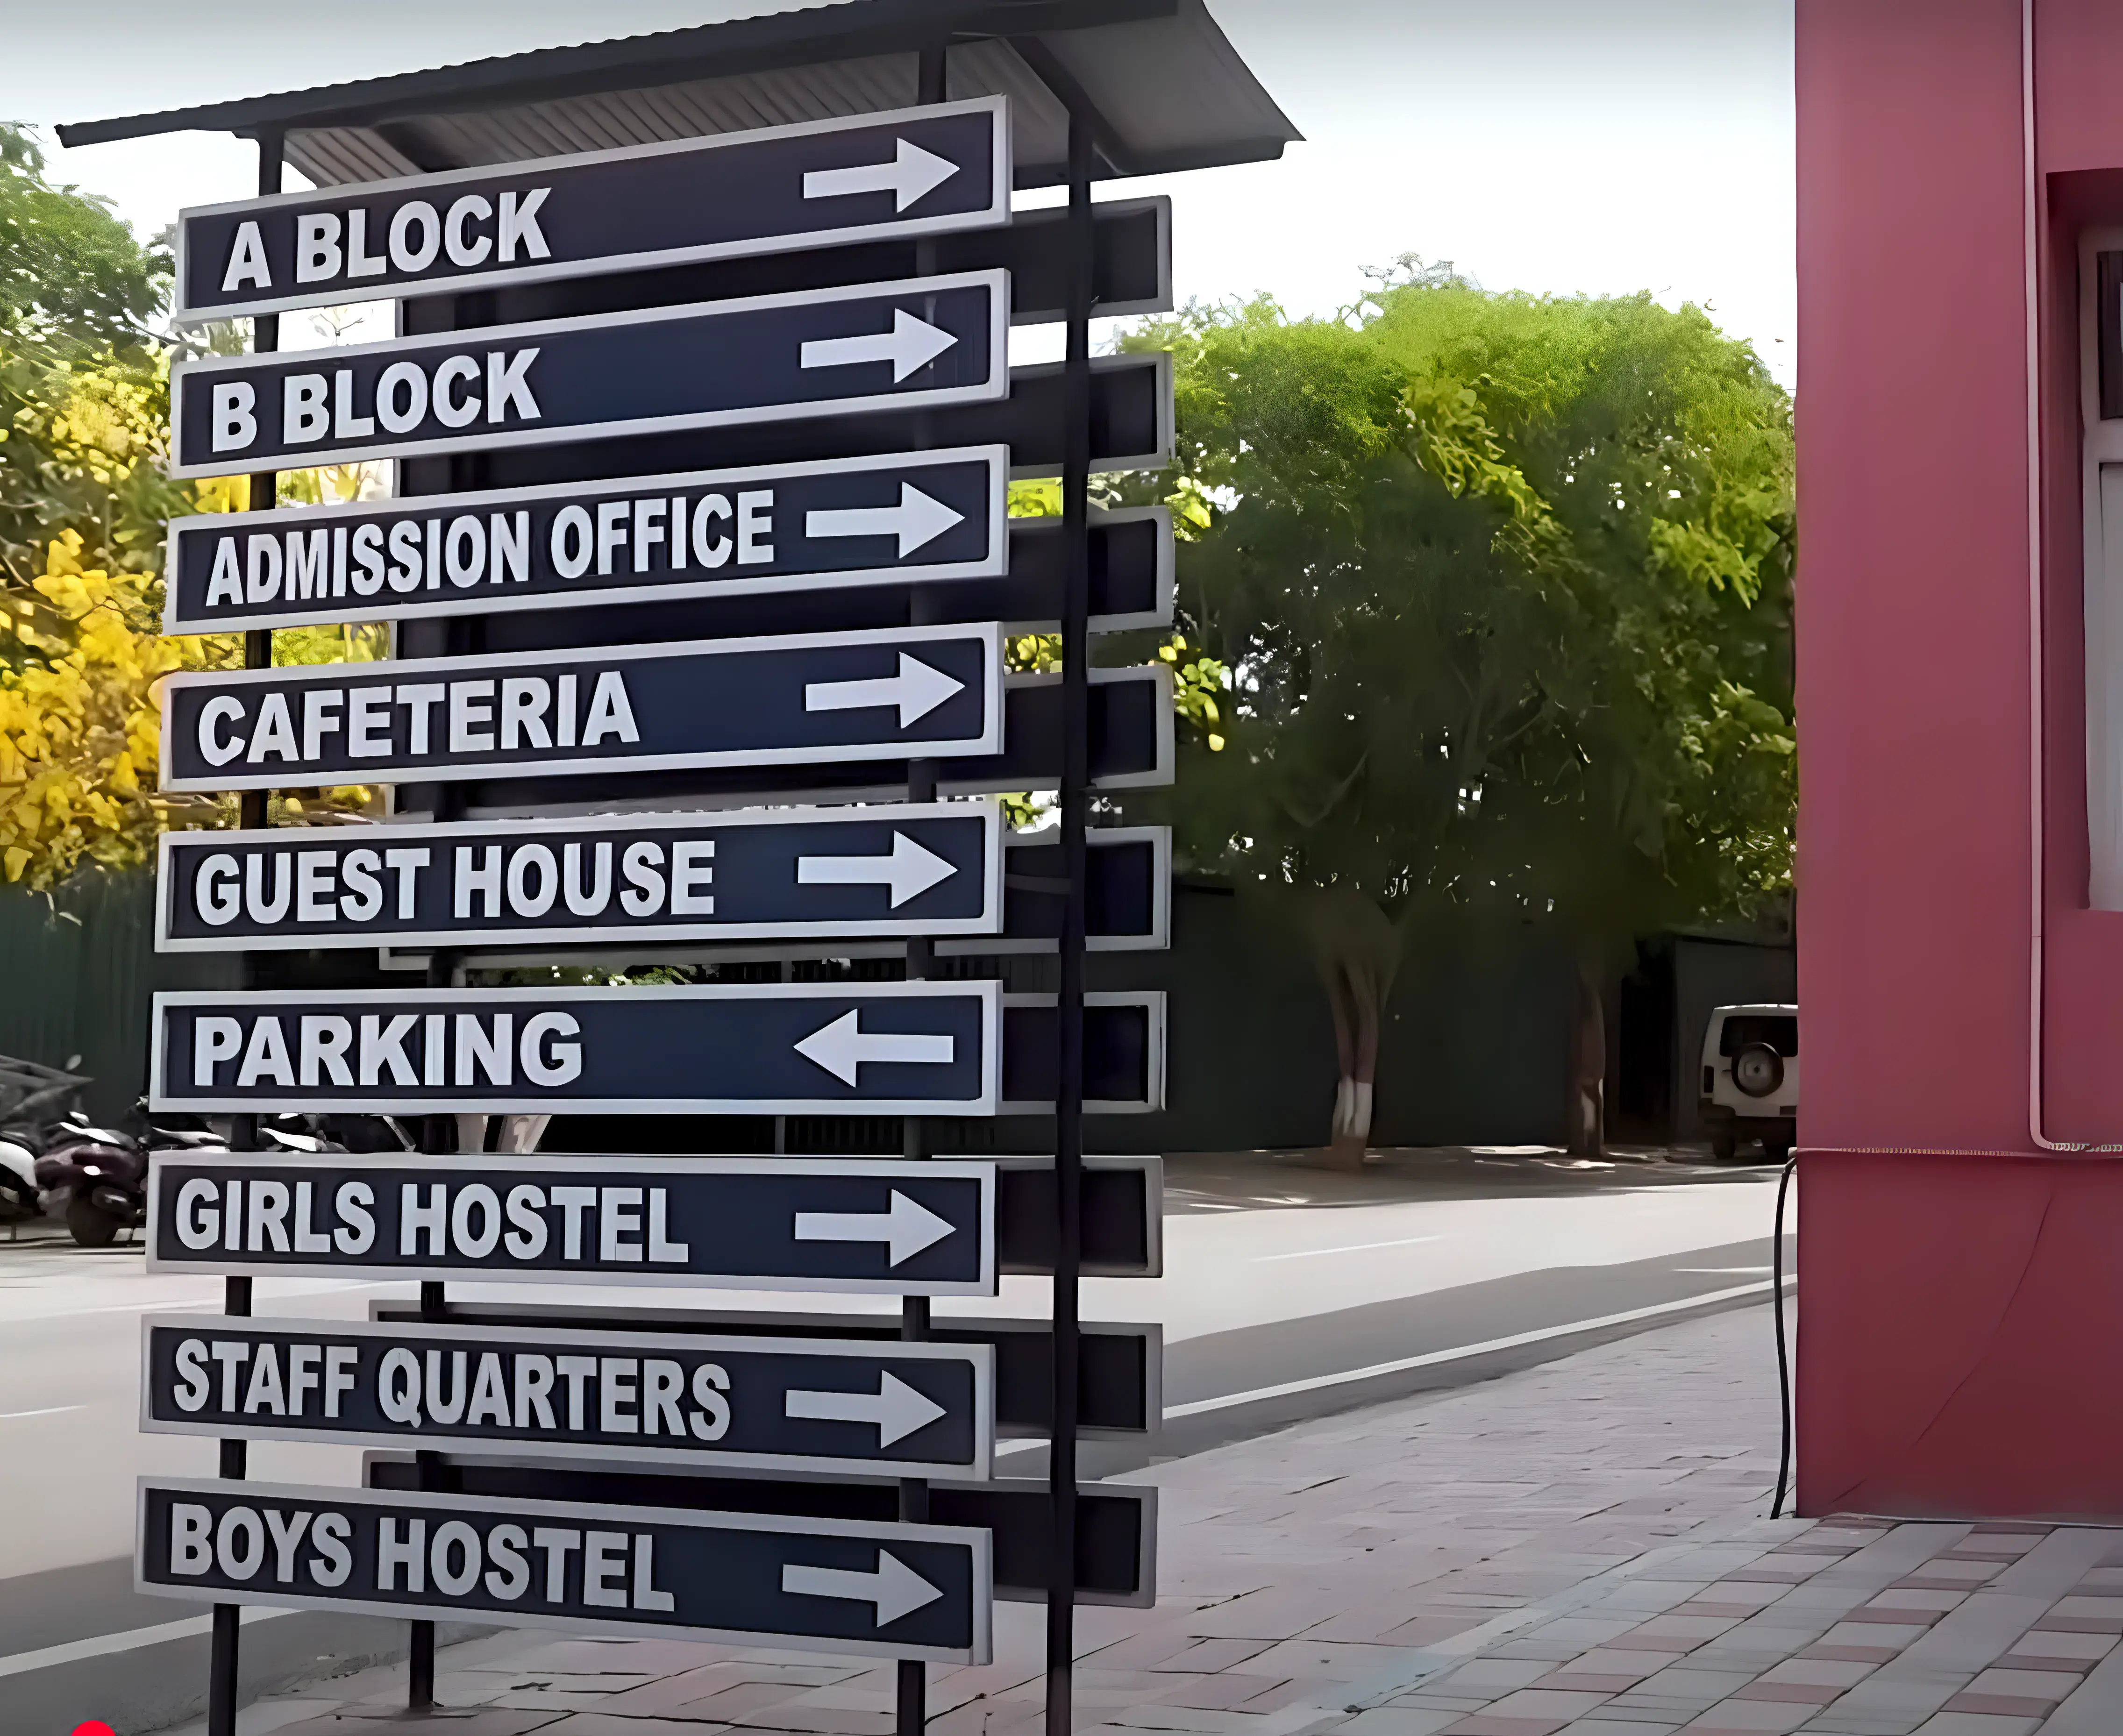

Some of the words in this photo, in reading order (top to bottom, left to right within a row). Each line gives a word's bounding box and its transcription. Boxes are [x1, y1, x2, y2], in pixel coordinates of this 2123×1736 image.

[222, 221, 271, 291] A
[297, 187, 551, 283] BLOCK
[213, 382, 256, 452] B
[284, 348, 541, 444] BLOCK
[206, 511, 529, 606] ADMISSION
[551, 490, 773, 578] OFFICE
[199, 671, 640, 766] CAFETERIA
[196, 848, 429, 925] GUEST
[455, 841, 714, 918] HOUSE
[195, 1012, 581, 1086] PARKING
[176, 1179, 375, 1254] GIRLS
[401, 1184, 688, 1262] HOSTEL
[174, 1339, 357, 1417] STAFF
[379, 1348, 730, 1440] QUARTERS
[171, 1503, 351, 1587] BOYS
[378, 1518, 674, 1611] HOSTEL
